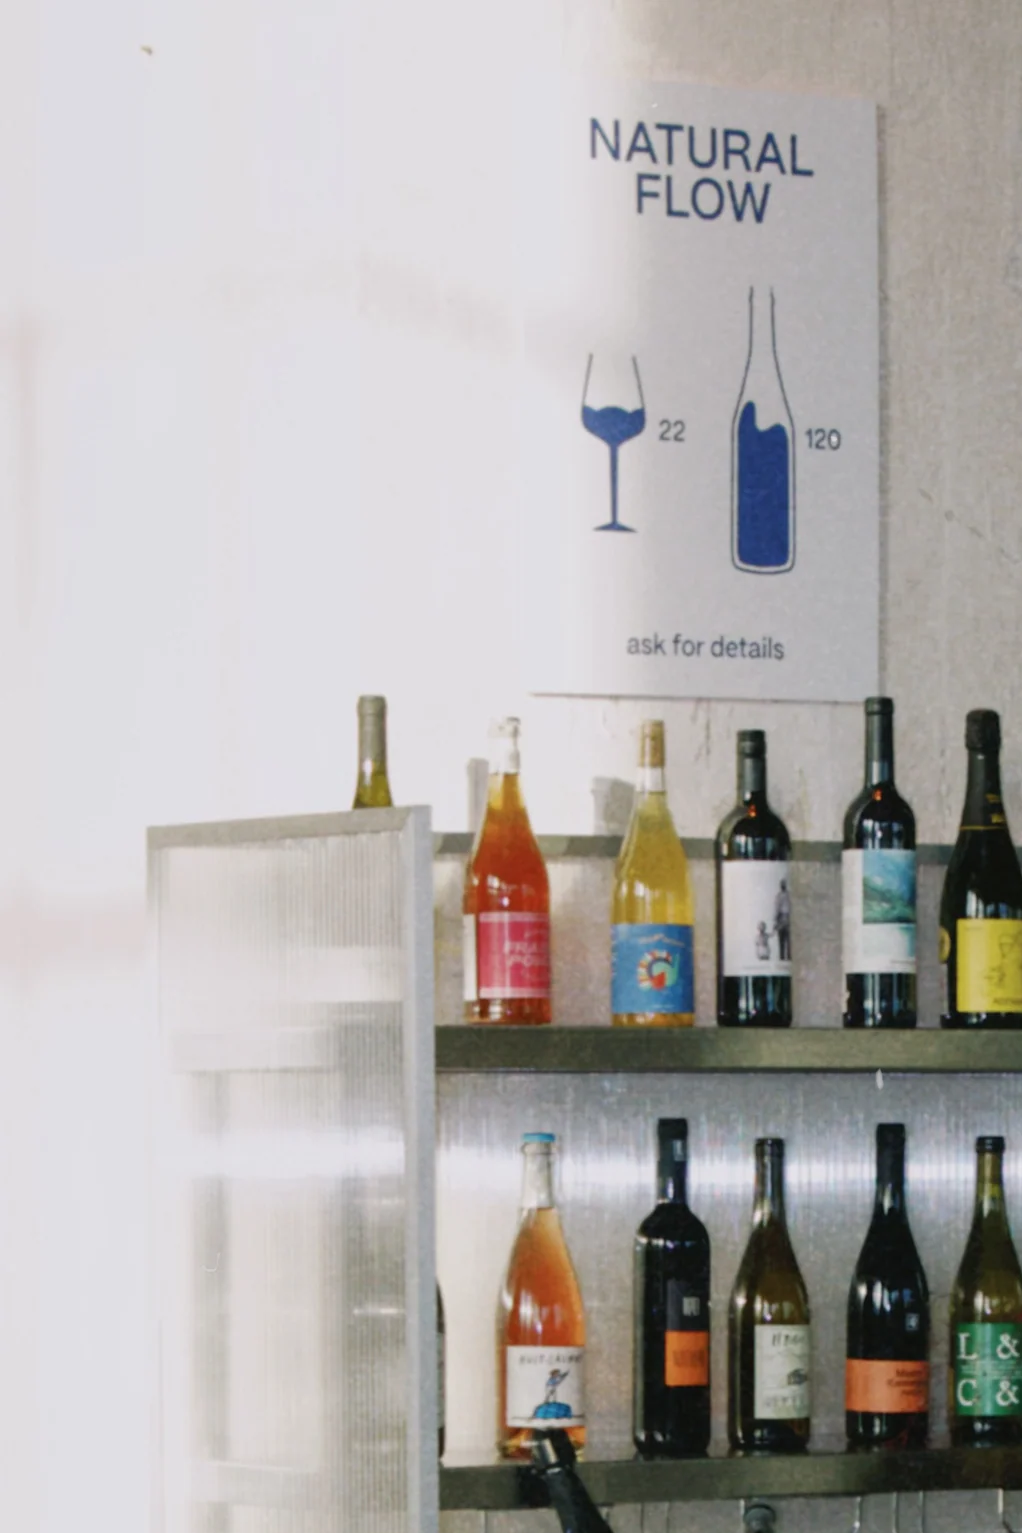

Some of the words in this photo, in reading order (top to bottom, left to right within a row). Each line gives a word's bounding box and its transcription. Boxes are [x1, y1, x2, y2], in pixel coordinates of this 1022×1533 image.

[590, 118, 814, 177] NATURAL
[637, 173, 771, 224] FLOW
[659, 419, 686, 442] 22
[805, 428, 842, 450] 120
[627, 632, 667, 656] ask
[673, 633, 705, 657] for
[710, 635, 785, 661] details
[957, 1332, 979, 1360] L
[996, 1332, 1020, 1360] &
[957, 1379, 978, 1407] C
[996, 1379, 1020, 1407] &
